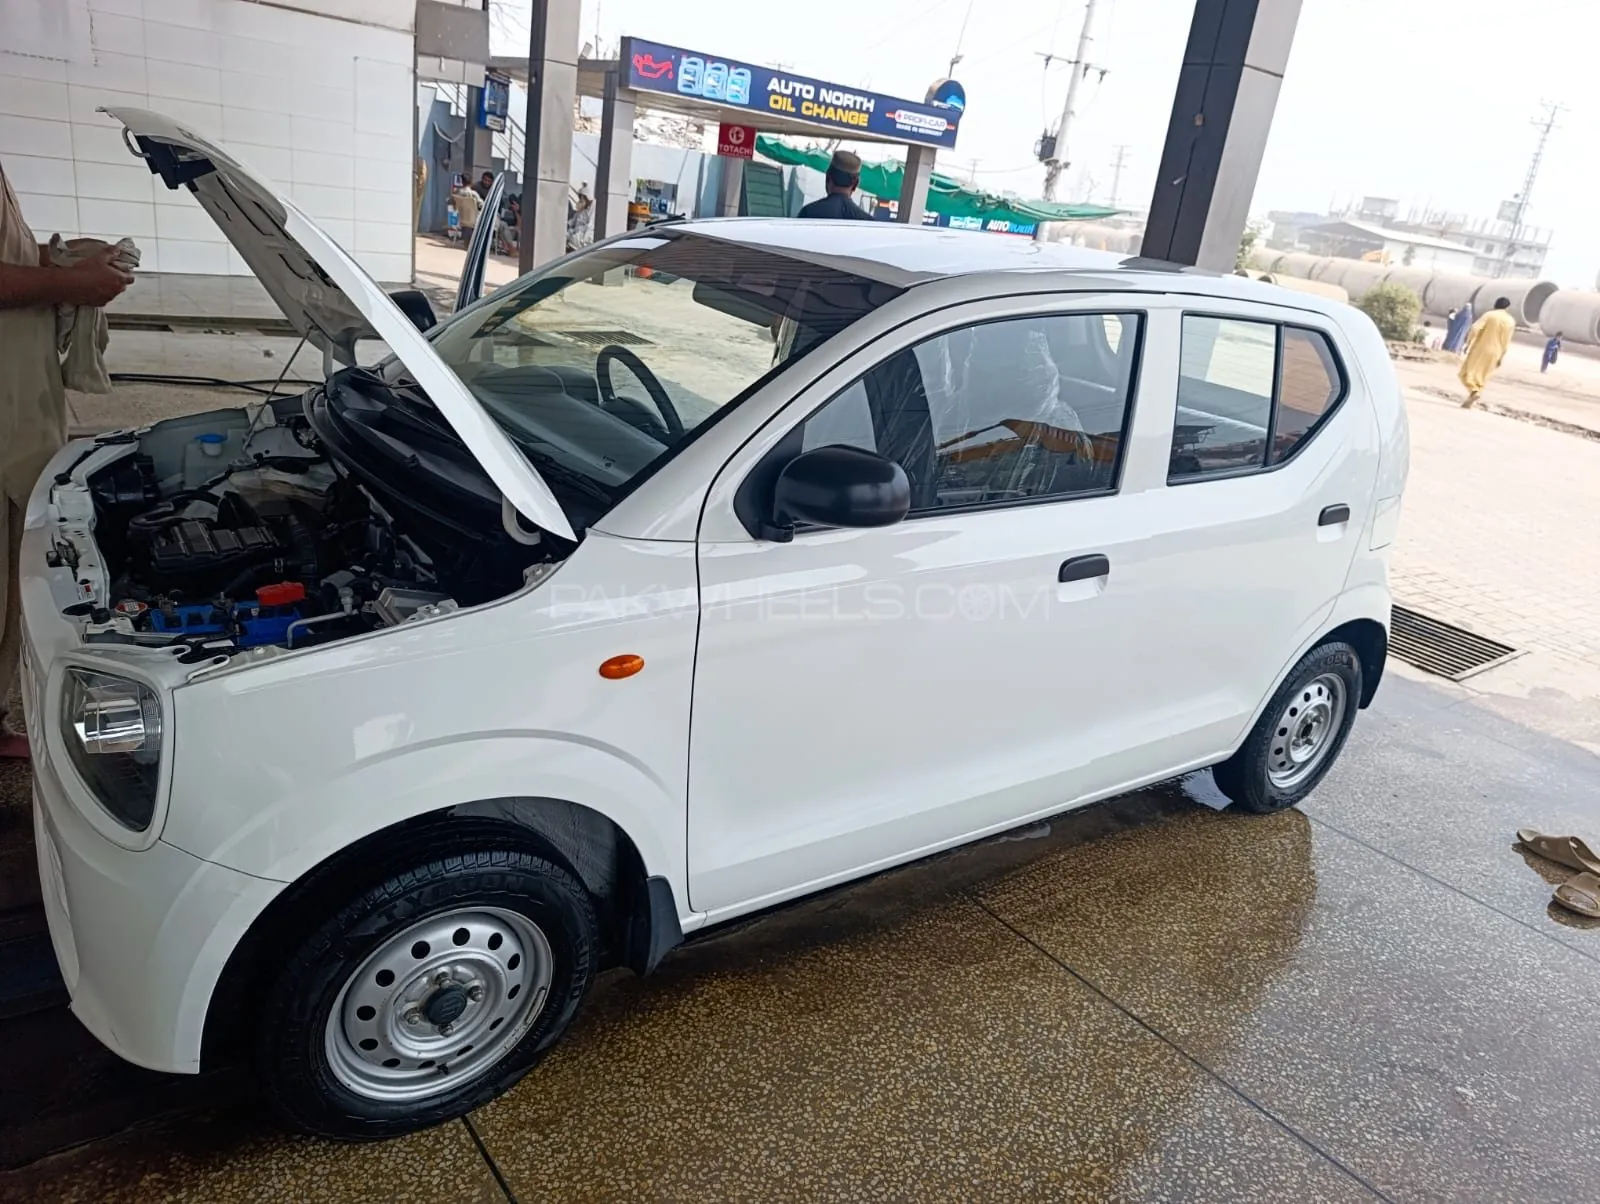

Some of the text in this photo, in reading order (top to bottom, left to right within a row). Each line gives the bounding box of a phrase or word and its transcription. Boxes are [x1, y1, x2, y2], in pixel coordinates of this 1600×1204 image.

[767, 77, 815, 99] AUTO
[819, 88, 875, 112] NORTH
[769, 94, 869, 127] OIL CHANGE
